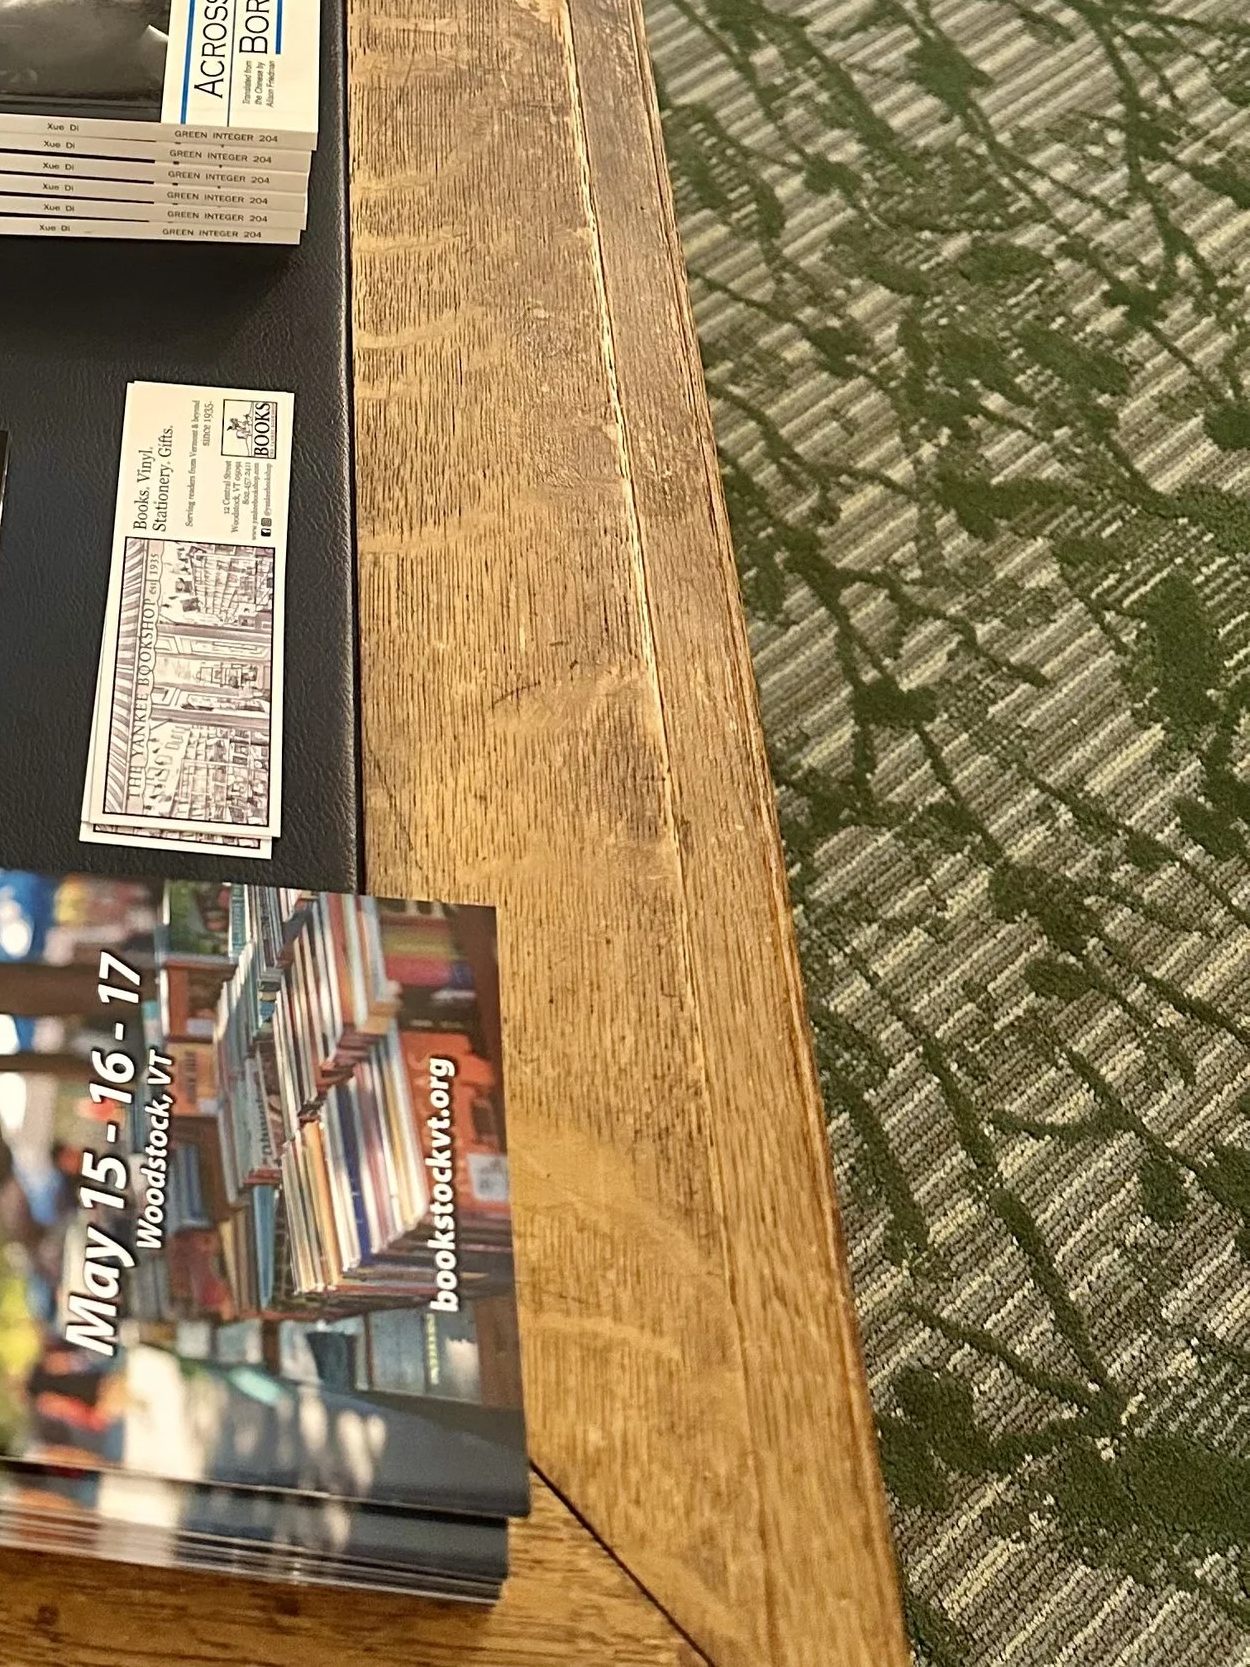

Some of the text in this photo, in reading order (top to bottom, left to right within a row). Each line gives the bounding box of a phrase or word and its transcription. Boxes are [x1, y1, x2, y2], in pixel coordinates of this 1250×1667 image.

[242, 75, 252, 105] Translated
[256, 70, 264, 93] Chinese
[47, 123, 66, 131] Xue
[69, 123, 79, 131] Di
[174, 129, 208, 139] GREEN
[212, 131, 254, 142] INTEGER
[258, 134, 278, 143] 204
[253, 402, 271, 457] BOOKS
[133, 446, 156, 530] Books. Vinyl.
[153, 424, 175, 532] Stationery. Gifts.
[188, 476, 196, 500] readers
[223, 481, 231, 505] Central
[233, 483, 241, 493] VT
[185, 501, 196, 527] Serving
[138, 600, 157, 688] BOOKSHOP
[130, 693, 150, 761] YANKEE
[128, 767, 143, 799] THE
[98, 951, 143, 1006] 17
[90, 1046, 136, 1106] 16
[136, 1048, 176, 1250] Woodstock, VT
[79, 1148, 128, 1212] 15
[425, 1056, 458, 1313] bookstockvt.org
[66, 1226, 136, 1355] May
